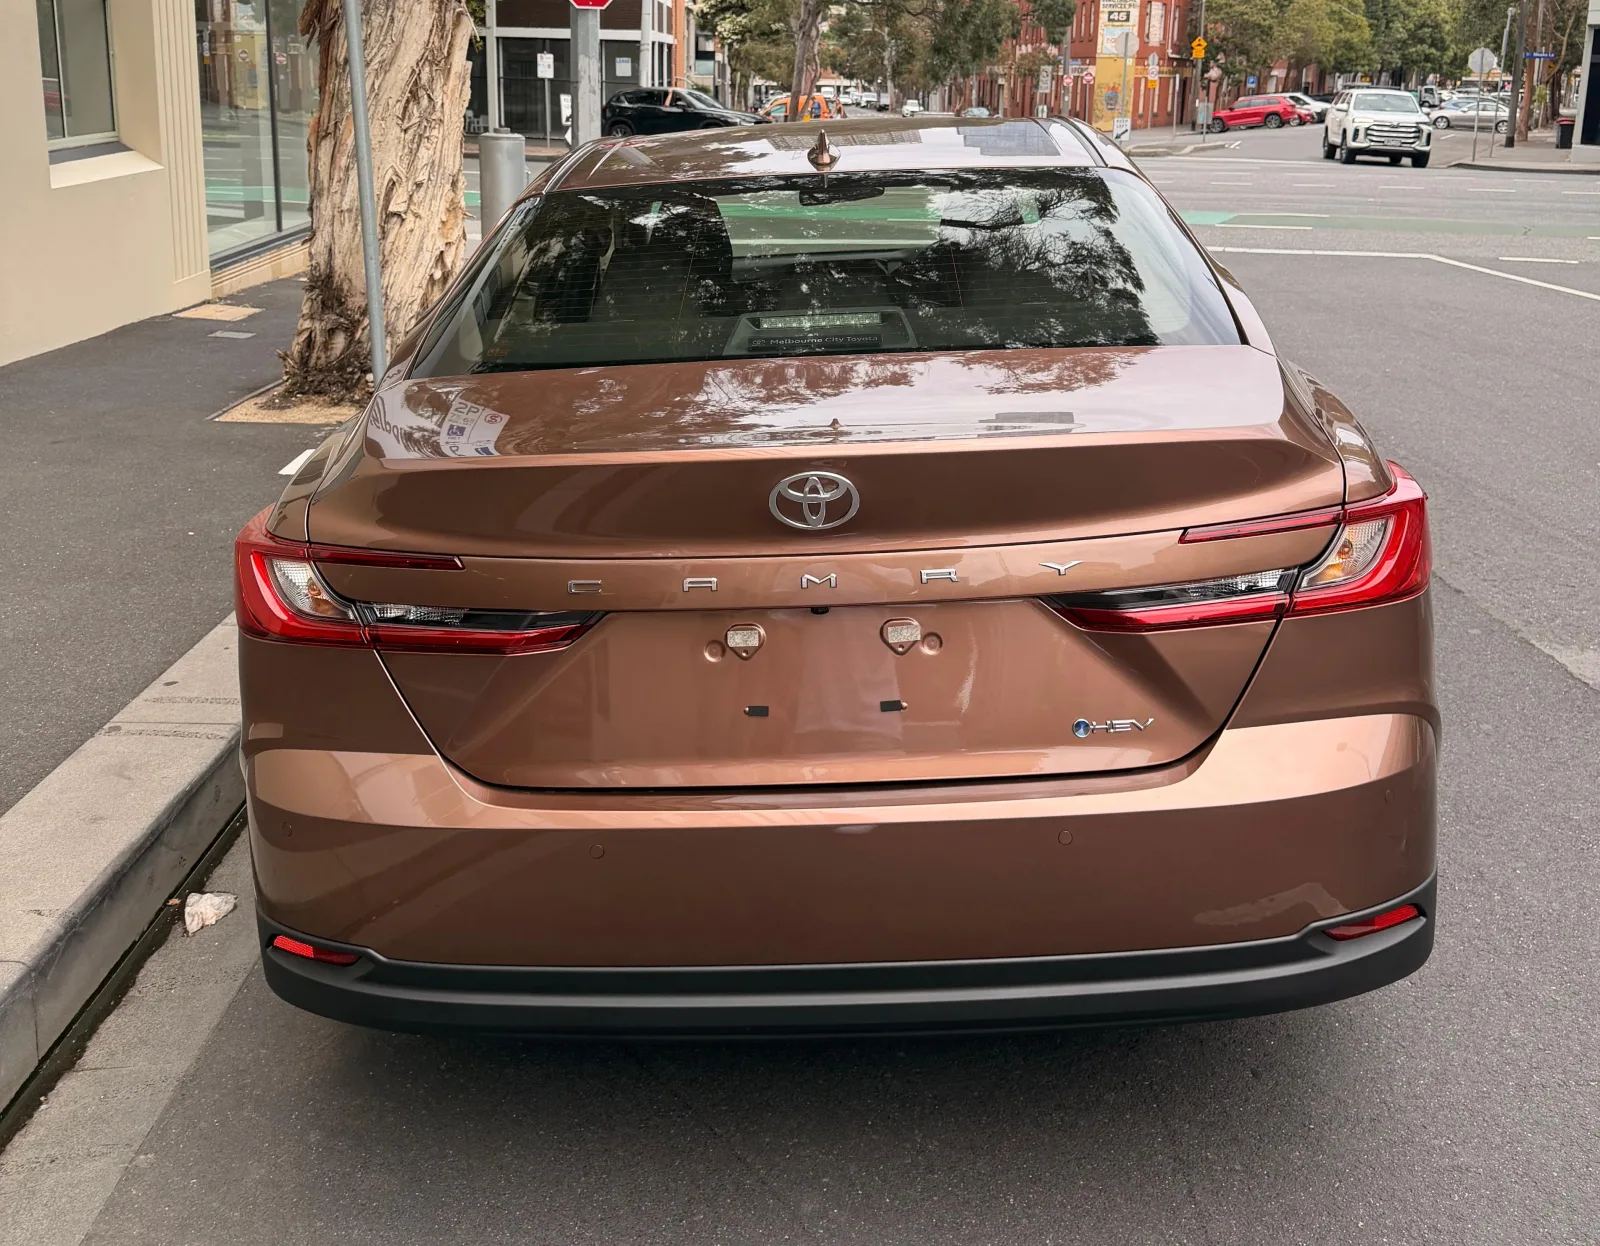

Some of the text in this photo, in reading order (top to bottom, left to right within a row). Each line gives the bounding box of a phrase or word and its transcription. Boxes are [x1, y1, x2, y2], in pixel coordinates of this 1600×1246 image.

[769, 335, 878, 345] Melbourne City Toyota
[566, 558, 1084, 595] CAMRY
[1090, 717, 1155, 734] HEV
